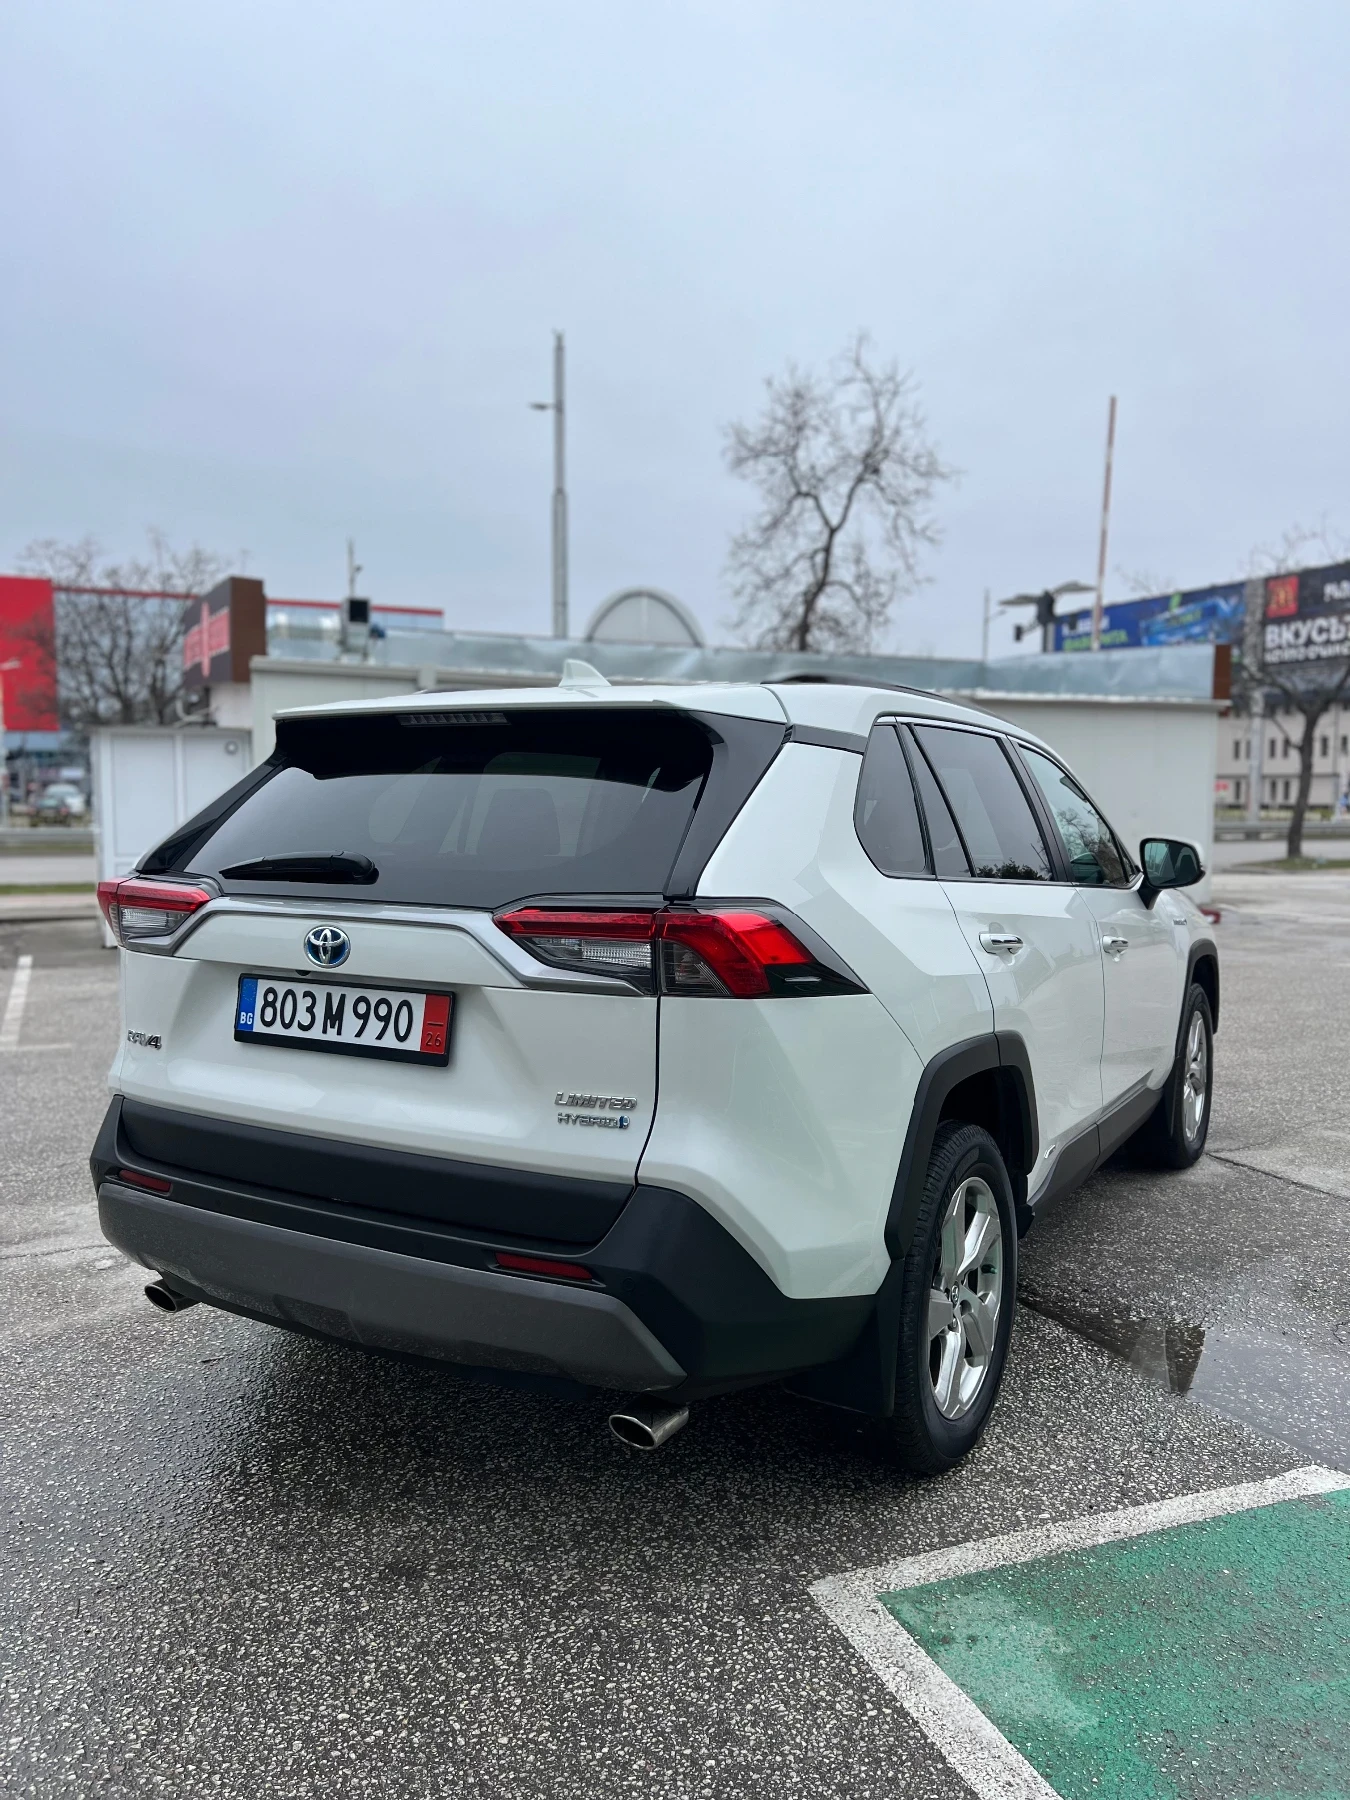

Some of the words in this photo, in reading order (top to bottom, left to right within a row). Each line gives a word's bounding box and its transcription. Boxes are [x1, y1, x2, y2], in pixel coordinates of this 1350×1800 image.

[240, 1011, 253, 1025] BG
[127, 1028, 162, 1050] RAV4
[425, 1031, 442, 1047] 26
[554, 1091, 638, 1111] LIMITED
[557, 1112, 619, 1129] HYBRID
